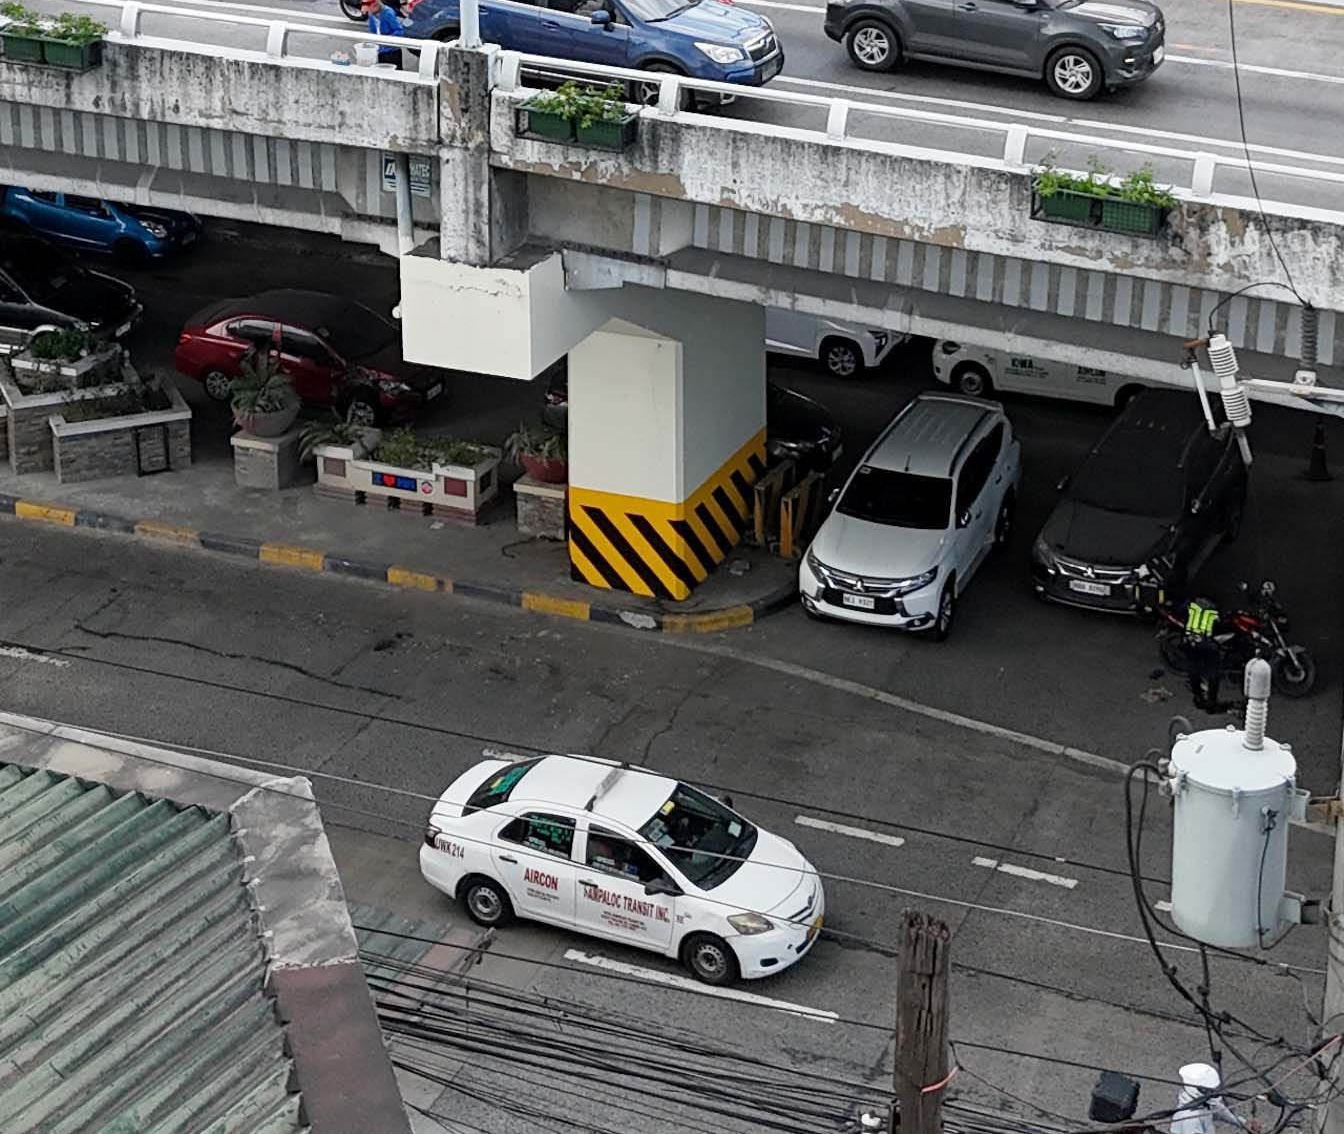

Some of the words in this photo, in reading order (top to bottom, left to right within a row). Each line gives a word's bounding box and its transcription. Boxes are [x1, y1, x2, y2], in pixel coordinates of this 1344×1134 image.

[452, 843, 466, 860] 214
[523, 867, 560, 892] AIRCON
[623, 896, 655, 919] TRANSIT
